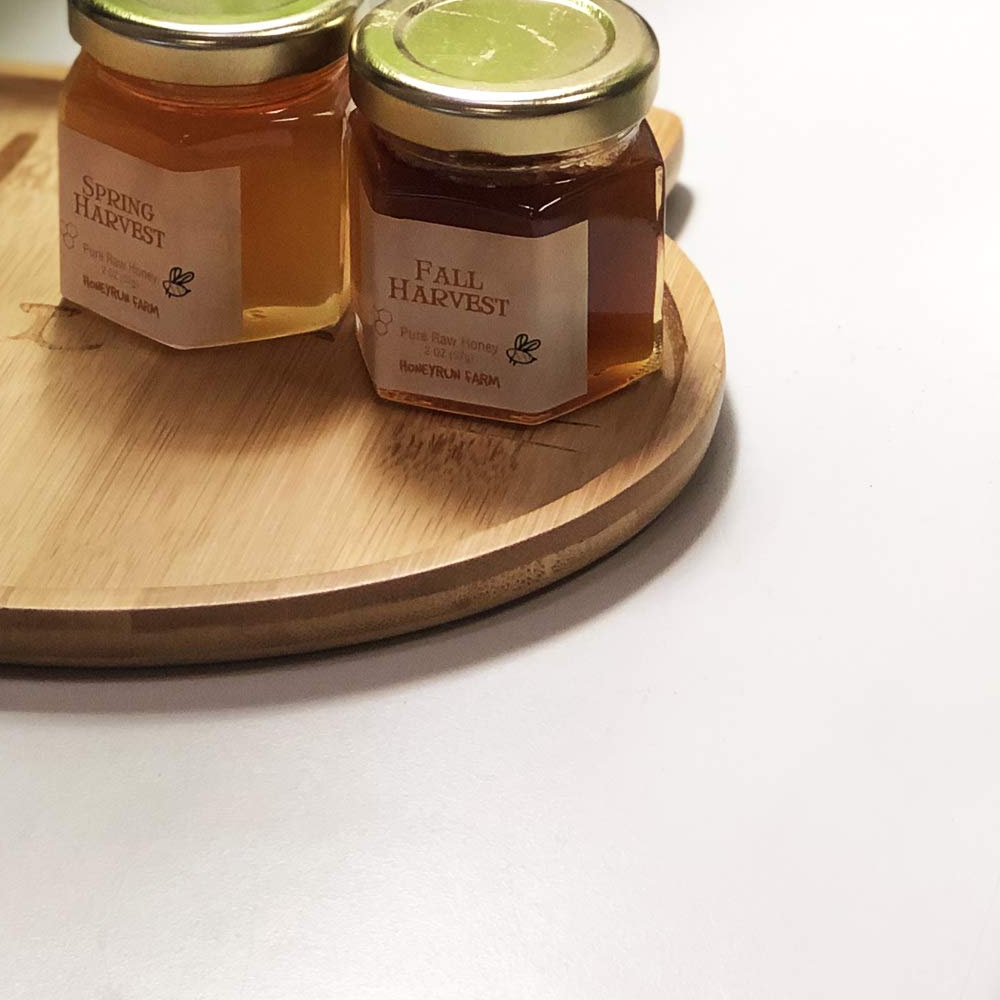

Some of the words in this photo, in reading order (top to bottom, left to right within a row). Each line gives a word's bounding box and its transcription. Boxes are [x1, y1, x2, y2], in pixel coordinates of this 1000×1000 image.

[81, 174, 155, 222] SPRING
[74, 191, 166, 249] HARVEST
[414, 258, 484, 291] FALL
[388, 276, 510, 317] HARVEST
[400, 326, 428, 342] Pure
[431, 331, 458, 347] Raw
[461, 336, 499, 356] Honey
[464, 370, 501, 389] FARM
